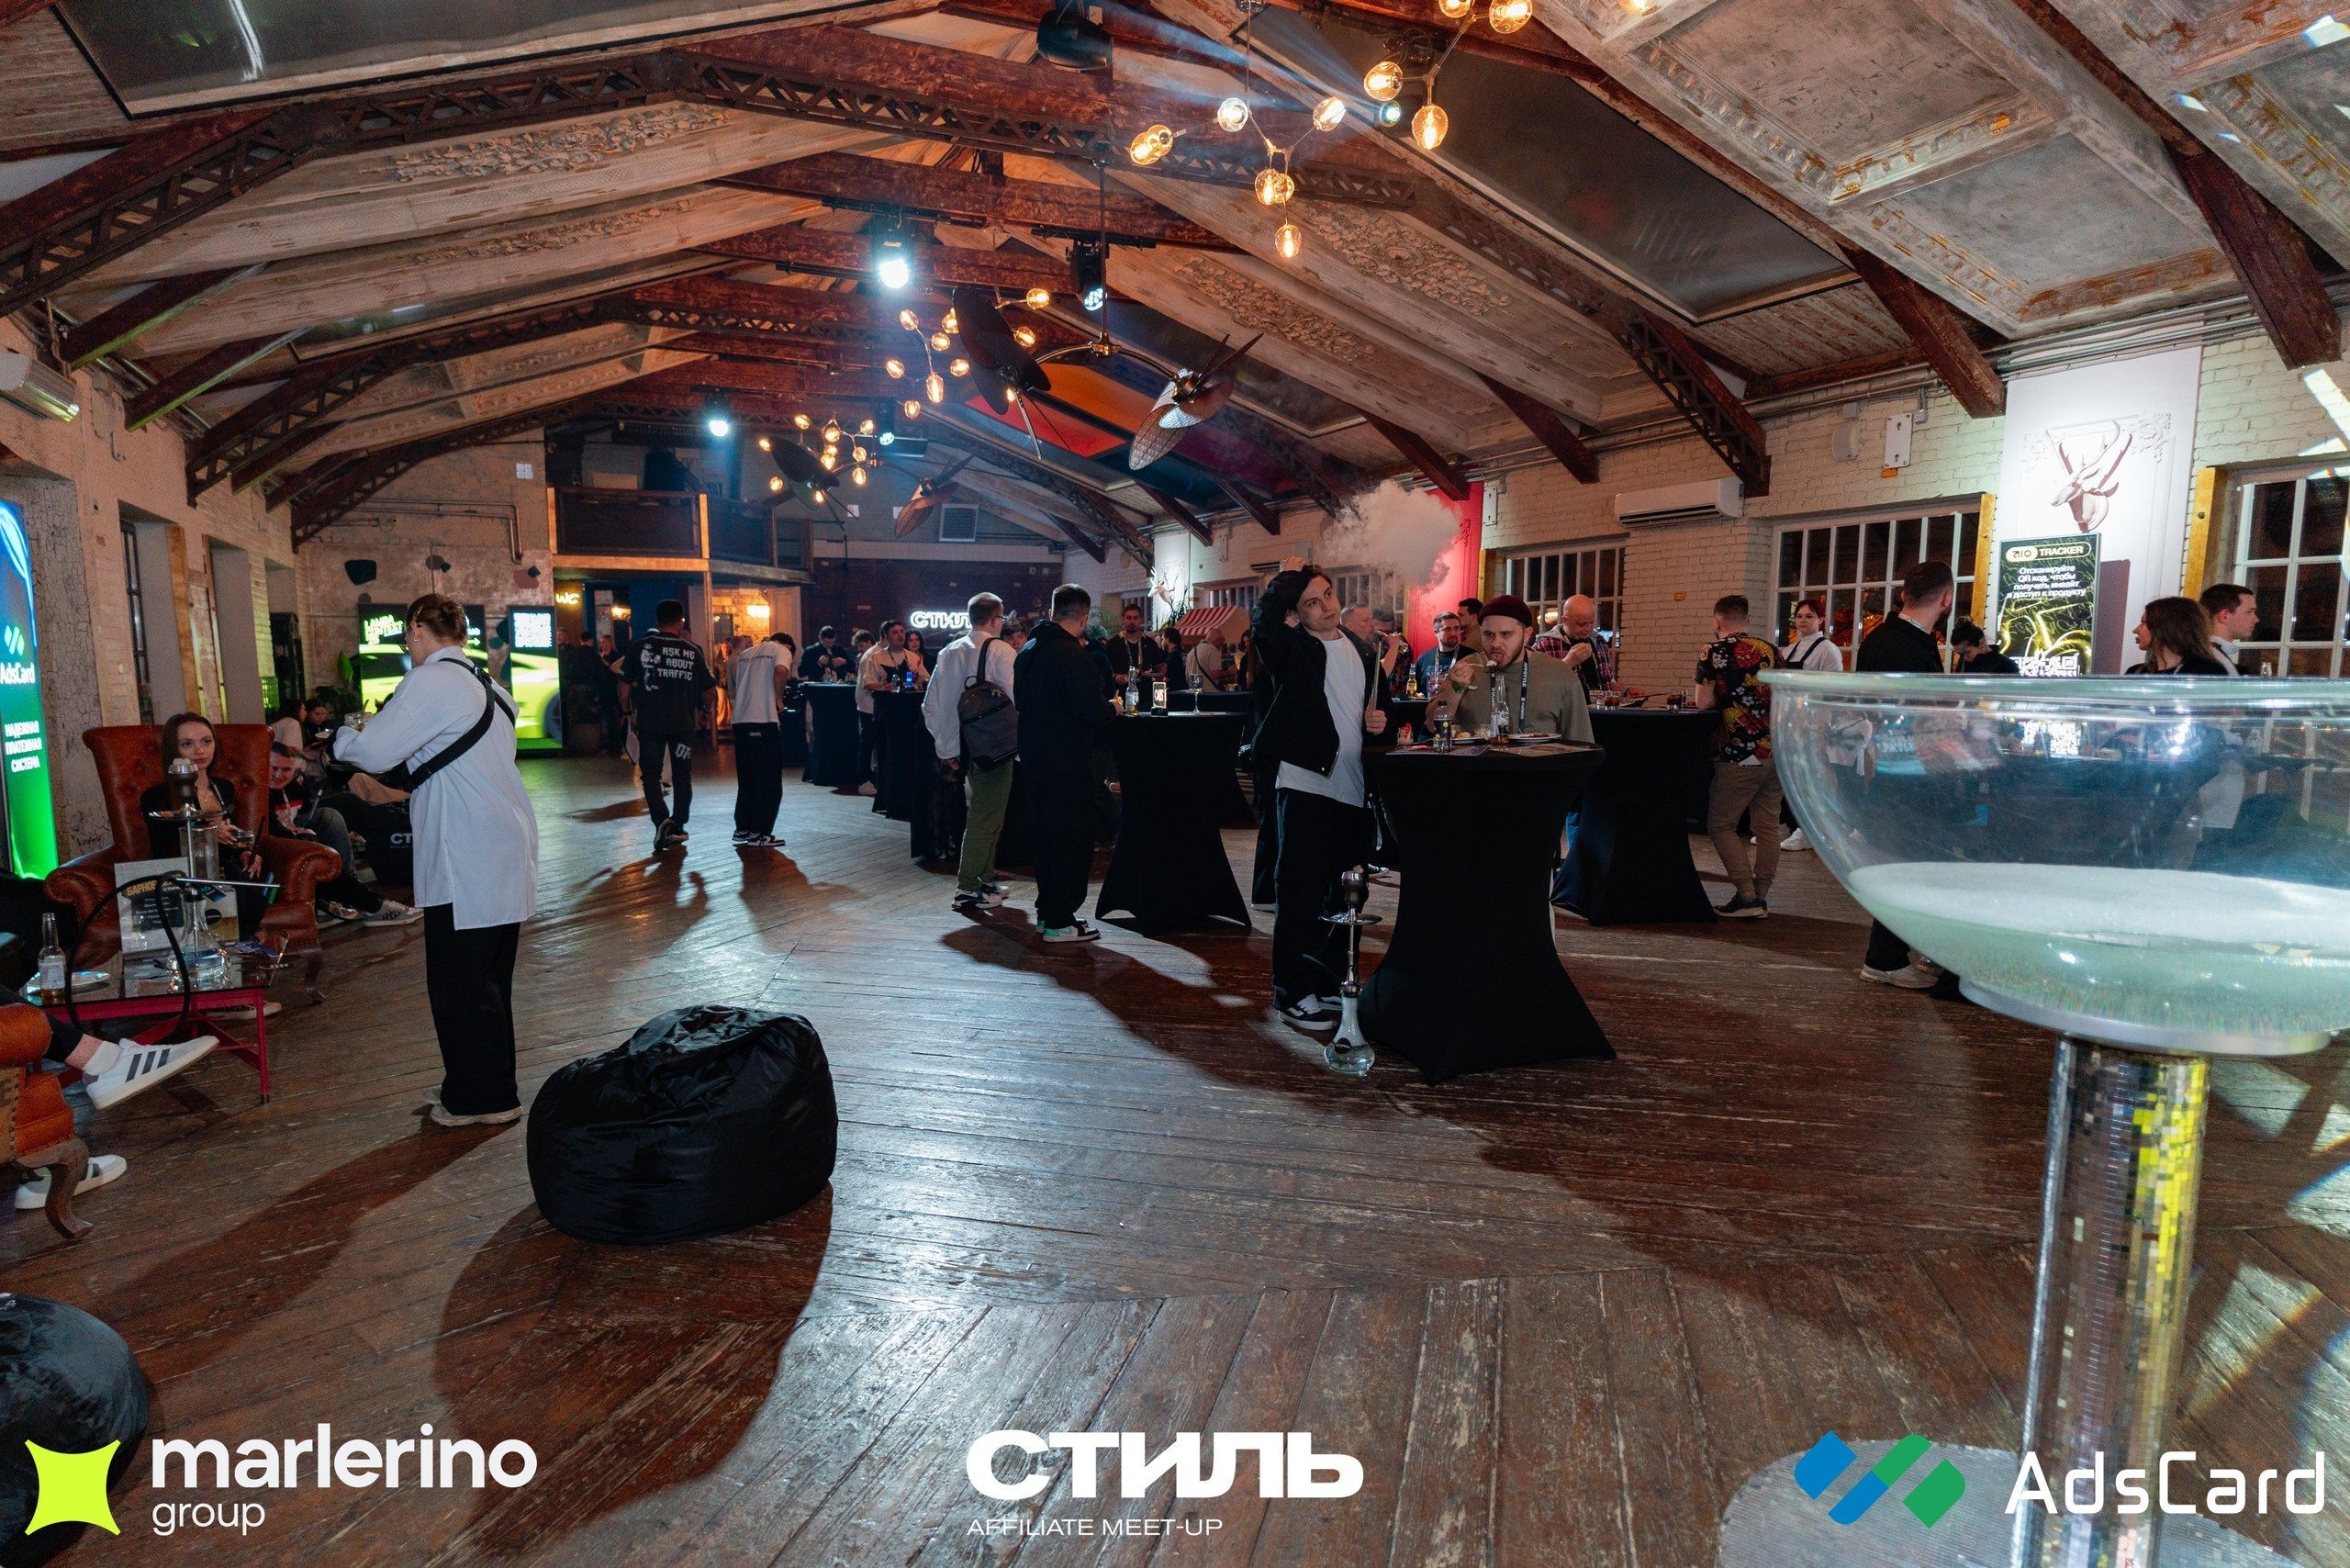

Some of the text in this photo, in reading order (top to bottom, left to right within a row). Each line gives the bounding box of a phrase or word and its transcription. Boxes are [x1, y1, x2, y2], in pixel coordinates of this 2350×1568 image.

[2039, 545, 2084, 556] TRACKER
[2019, 565, 2076, 575] Отсканируйте
[2018, 575, 2031, 583] QR
[2051, 572, 2076, 581] чтобы
[2013, 580, 2080, 592] получить инвайт
[555, 591, 580, 605] WC
[2013, 590, 2042, 599] доступ
[2048, 588, 2087, 598] продукту
[910, 610, 971, 629] СТИЛ
[662, 646, 696, 660] ASK ME
[666, 657, 695, 671] ABOUT
[0, 662, 36, 684] AdsCard
[656, 667, 693, 681] TRAFFIC
[5, 721, 39, 738] НАДЕЖНАЯ
[5, 737, 43, 756] ПЛАТЕЖНАЯ
[11, 756, 41, 773] СИСТЕМА
